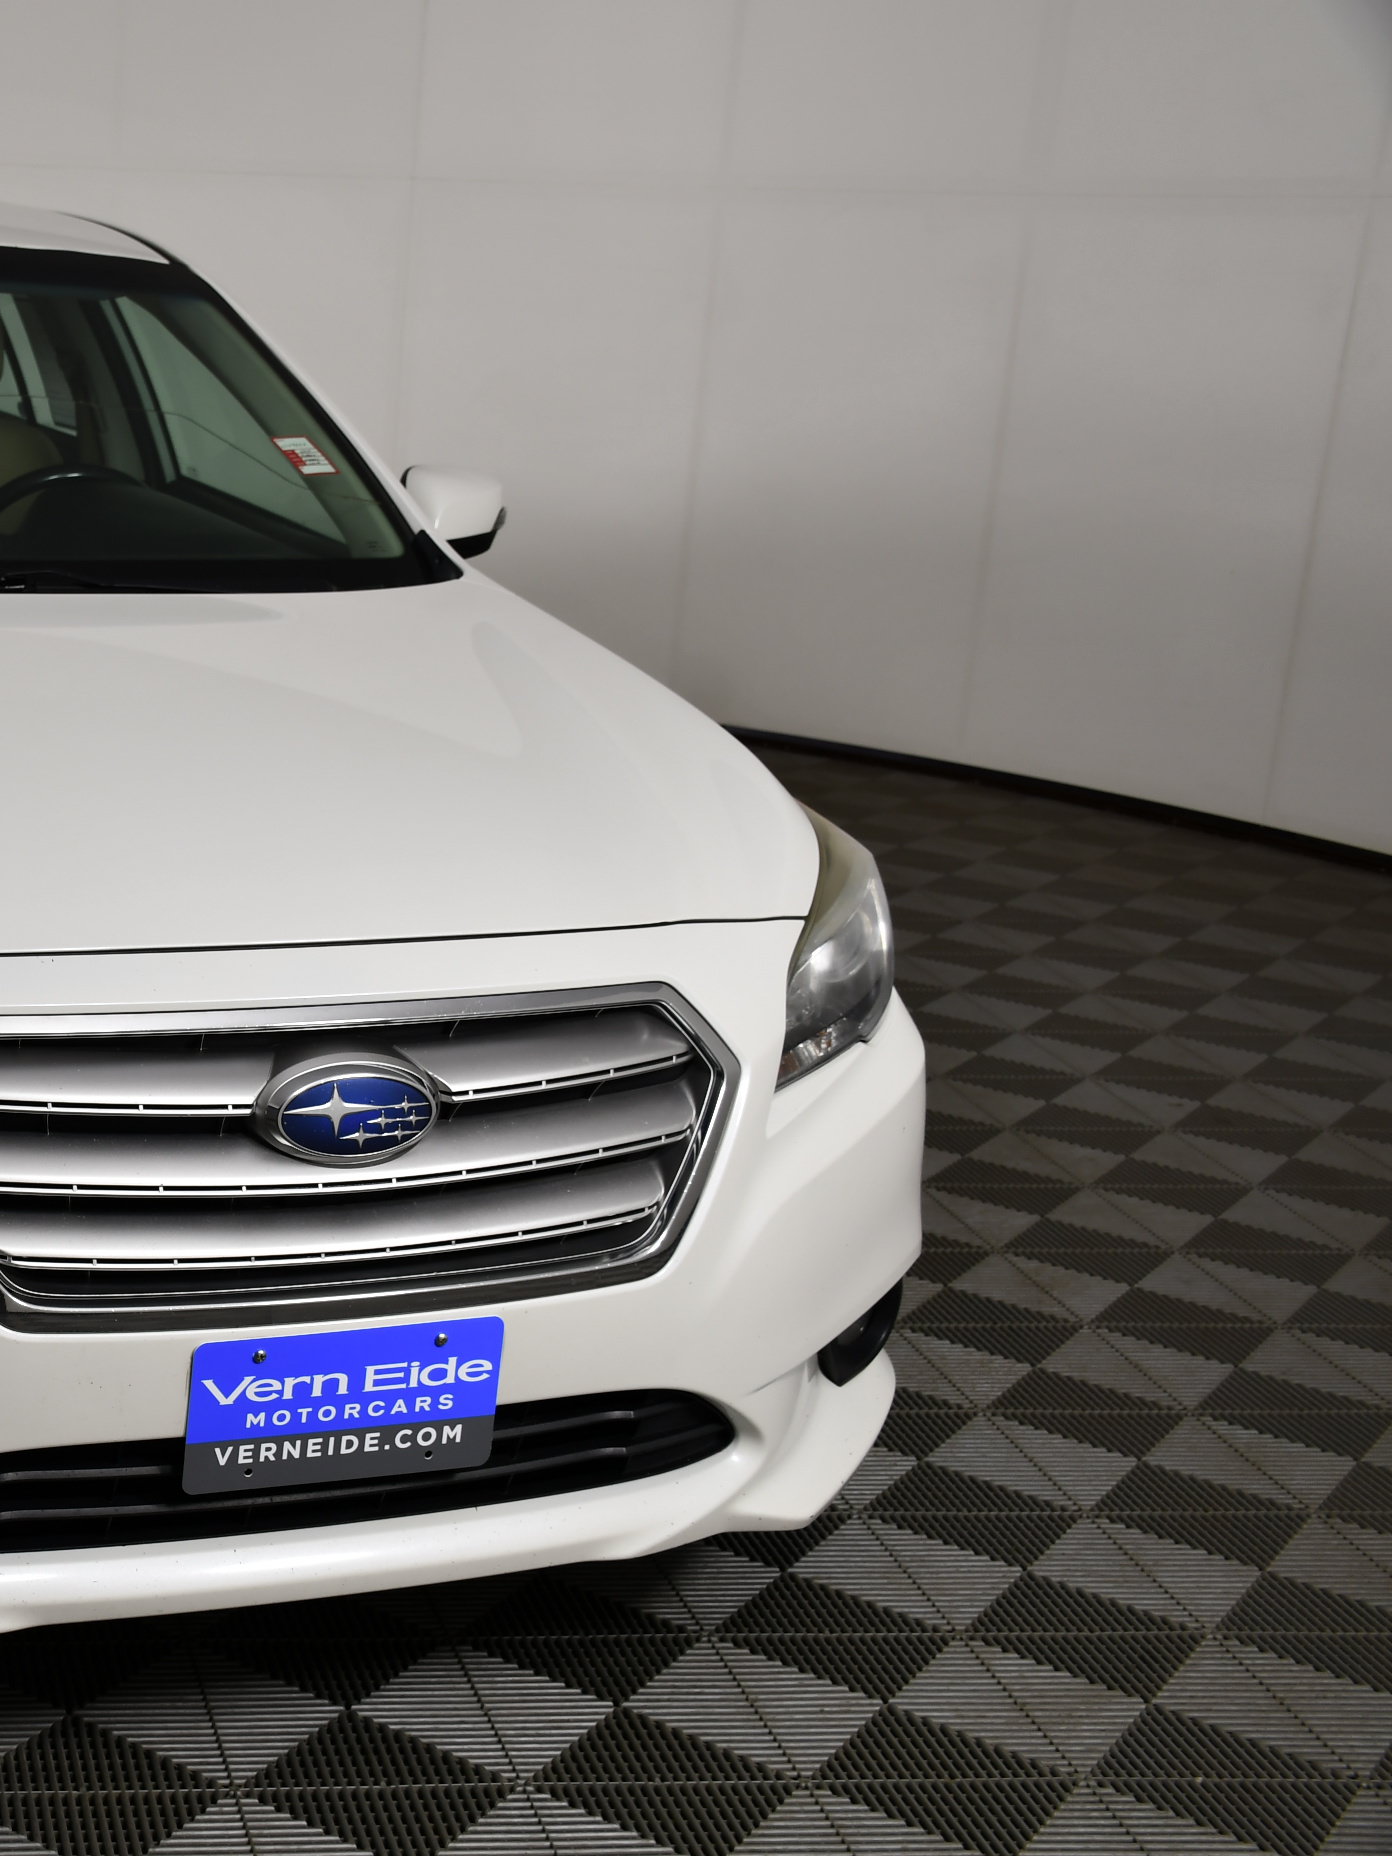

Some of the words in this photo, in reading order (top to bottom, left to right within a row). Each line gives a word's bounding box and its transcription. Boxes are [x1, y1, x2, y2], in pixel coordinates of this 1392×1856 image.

[201, 1372, 349, 1405] Vern
[362, 1356, 493, 1393] Eide
[245, 1394, 455, 1429] MOTORCARS
[214, 1423, 463, 1466] VERNEIDE.COM
